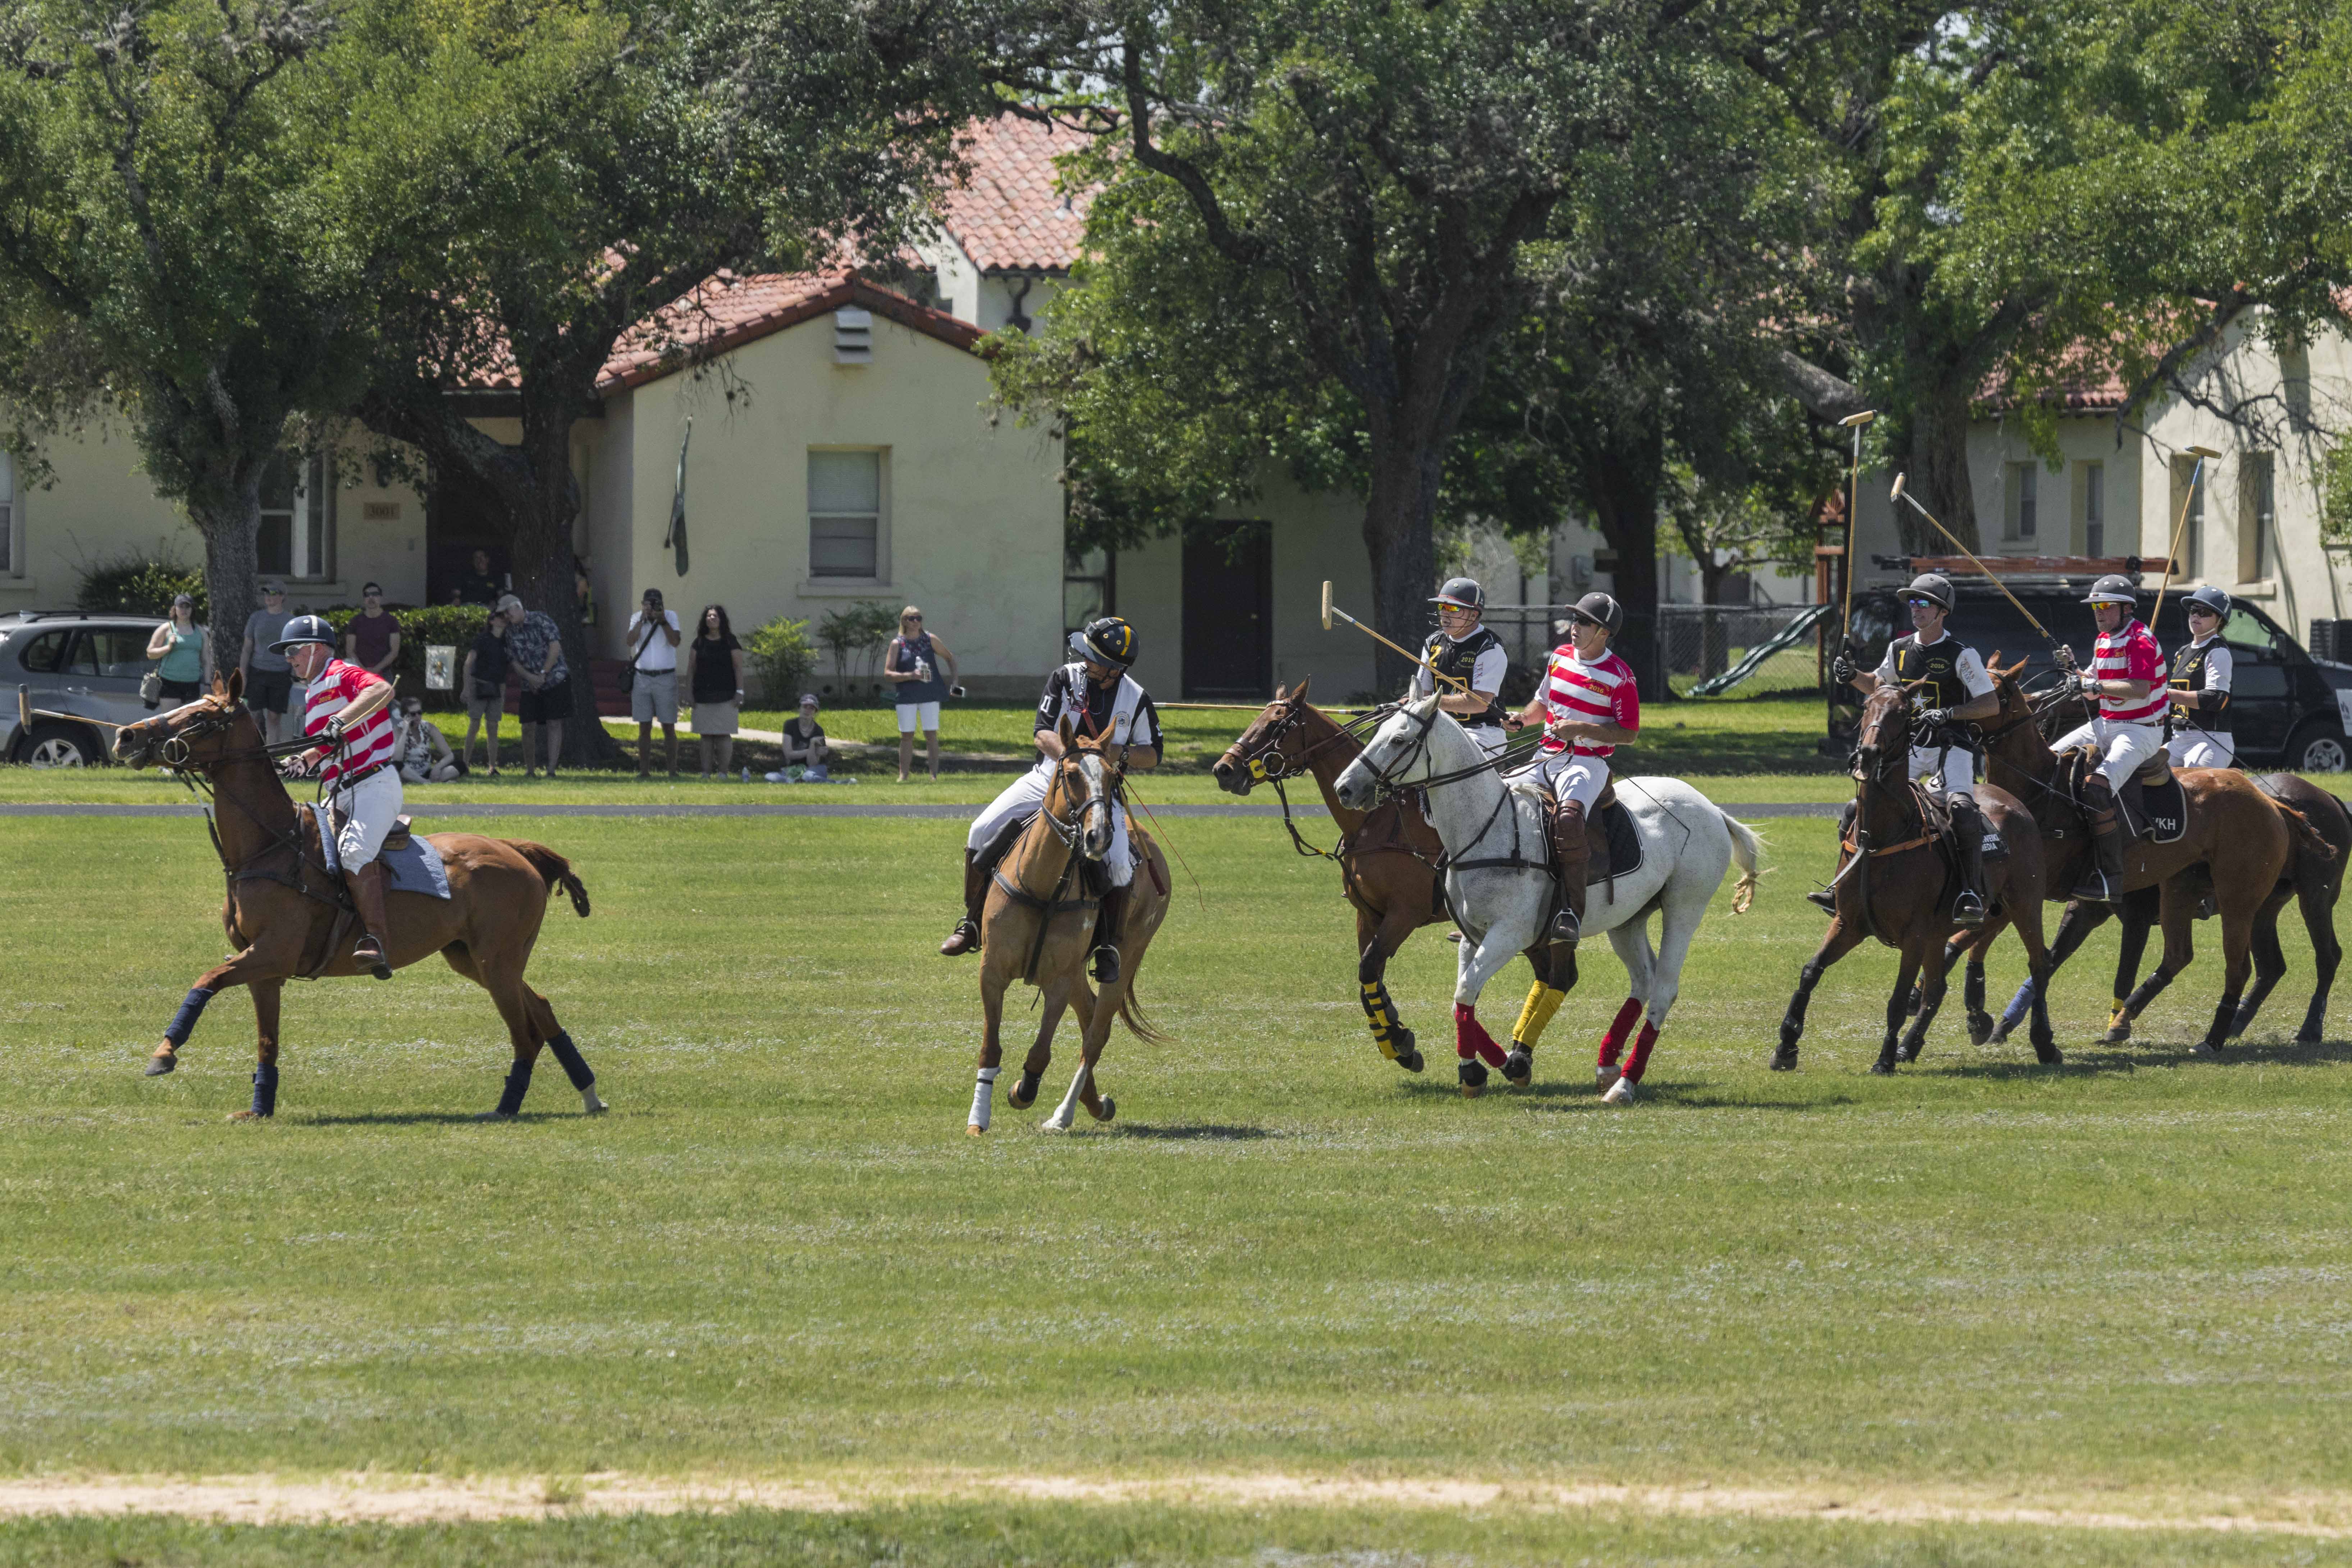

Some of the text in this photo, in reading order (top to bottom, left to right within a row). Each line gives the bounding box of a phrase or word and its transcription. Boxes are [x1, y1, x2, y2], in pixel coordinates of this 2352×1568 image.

[1429, 645, 1442, 667] 2
[1899, 650, 1906, 671] 1
[1475, 662, 1484, 685] TEXS
[1589, 684, 1604, 694] 2016
[1982, 834, 2000, 843] WEIKI
